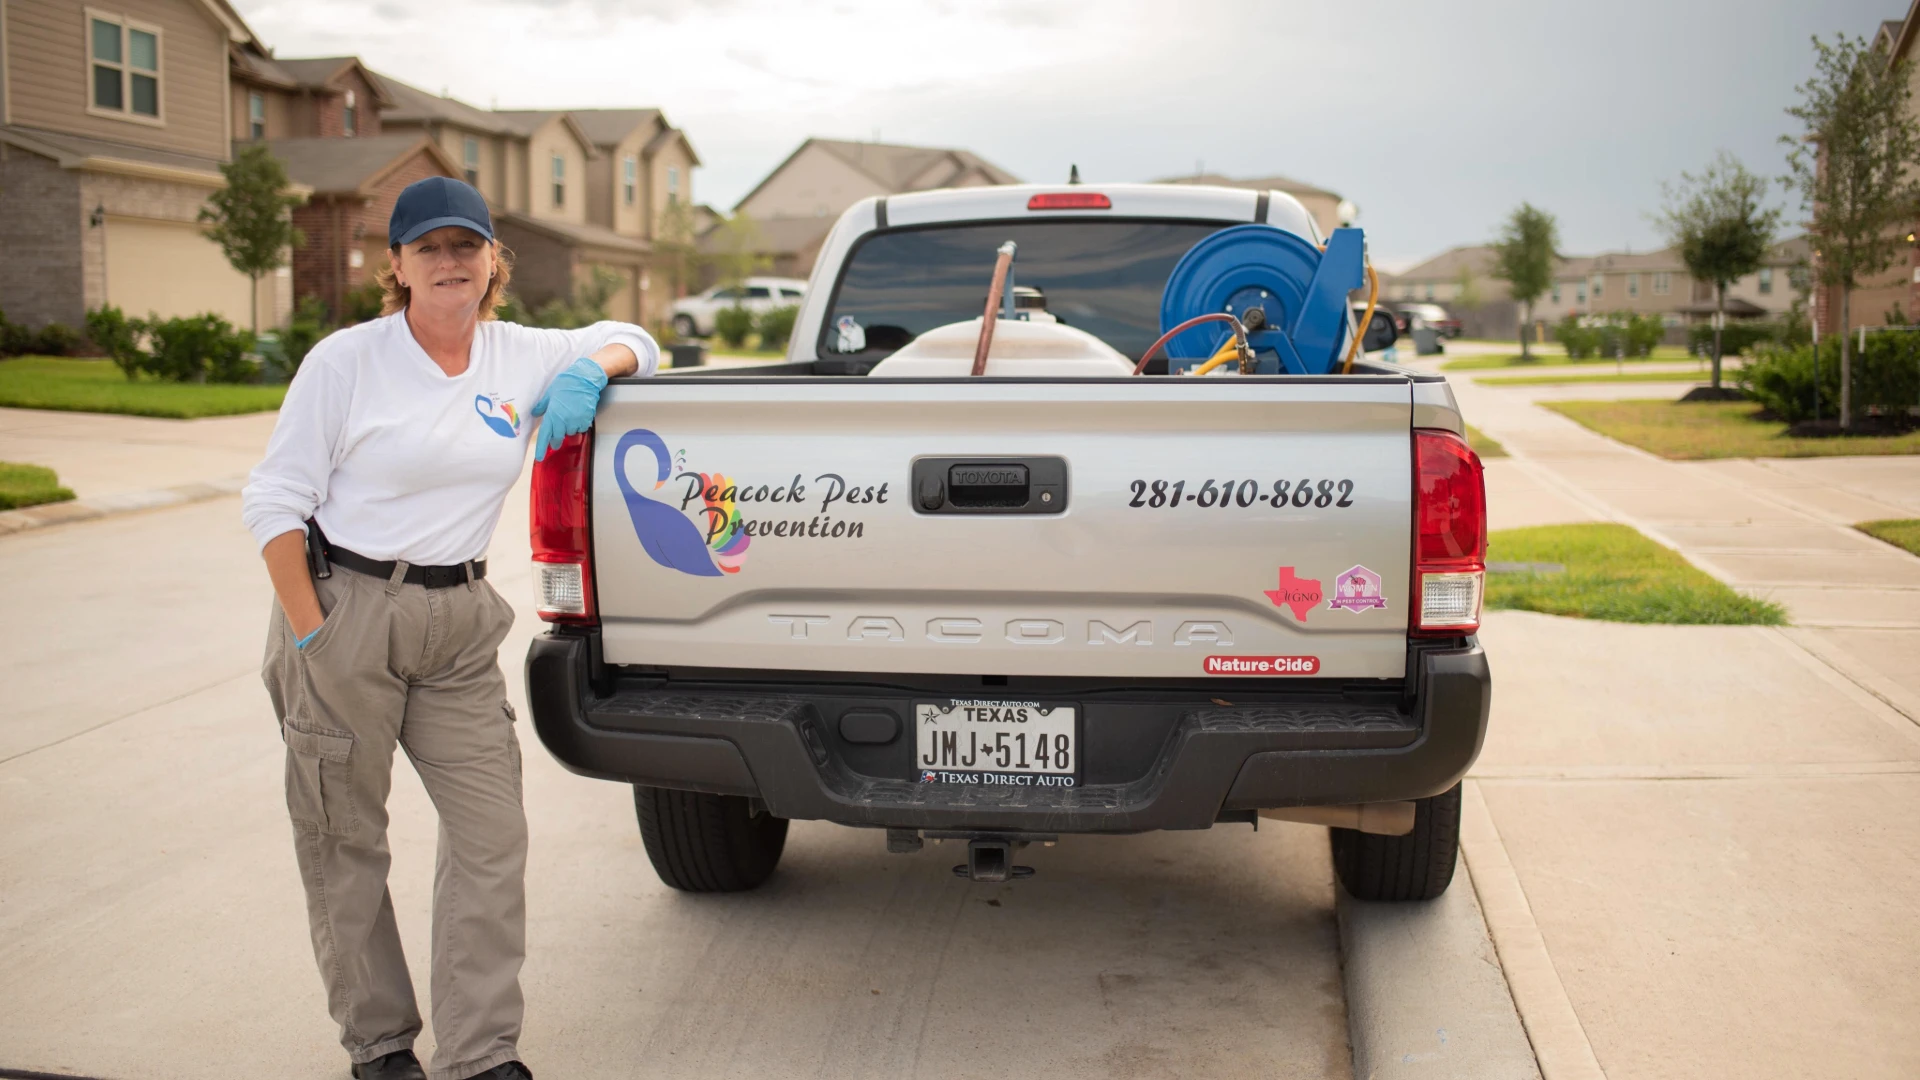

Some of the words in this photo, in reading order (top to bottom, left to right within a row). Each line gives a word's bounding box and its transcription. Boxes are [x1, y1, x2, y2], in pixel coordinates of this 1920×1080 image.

[675, 472, 806, 511] Peacock
[814, 473, 889, 512] Pest
[955, 469, 1024, 486] TOYOTA
[1128, 478, 1354, 509] 281-610-8682
[699, 506, 865, 545] Prevention
[1338, 584, 1378, 593] WOMEN
[767, 613, 1235, 646] TACOMA
[964, 708, 1028, 723] TEXAS
[923, 731, 977, 767] JMJ
[996, 732, 1069, 769] 5148
[939, 772, 978, 784] TEXAS
[983, 773, 1033, 785] DIRECT
[1036, 774, 1074, 787] AUTO
